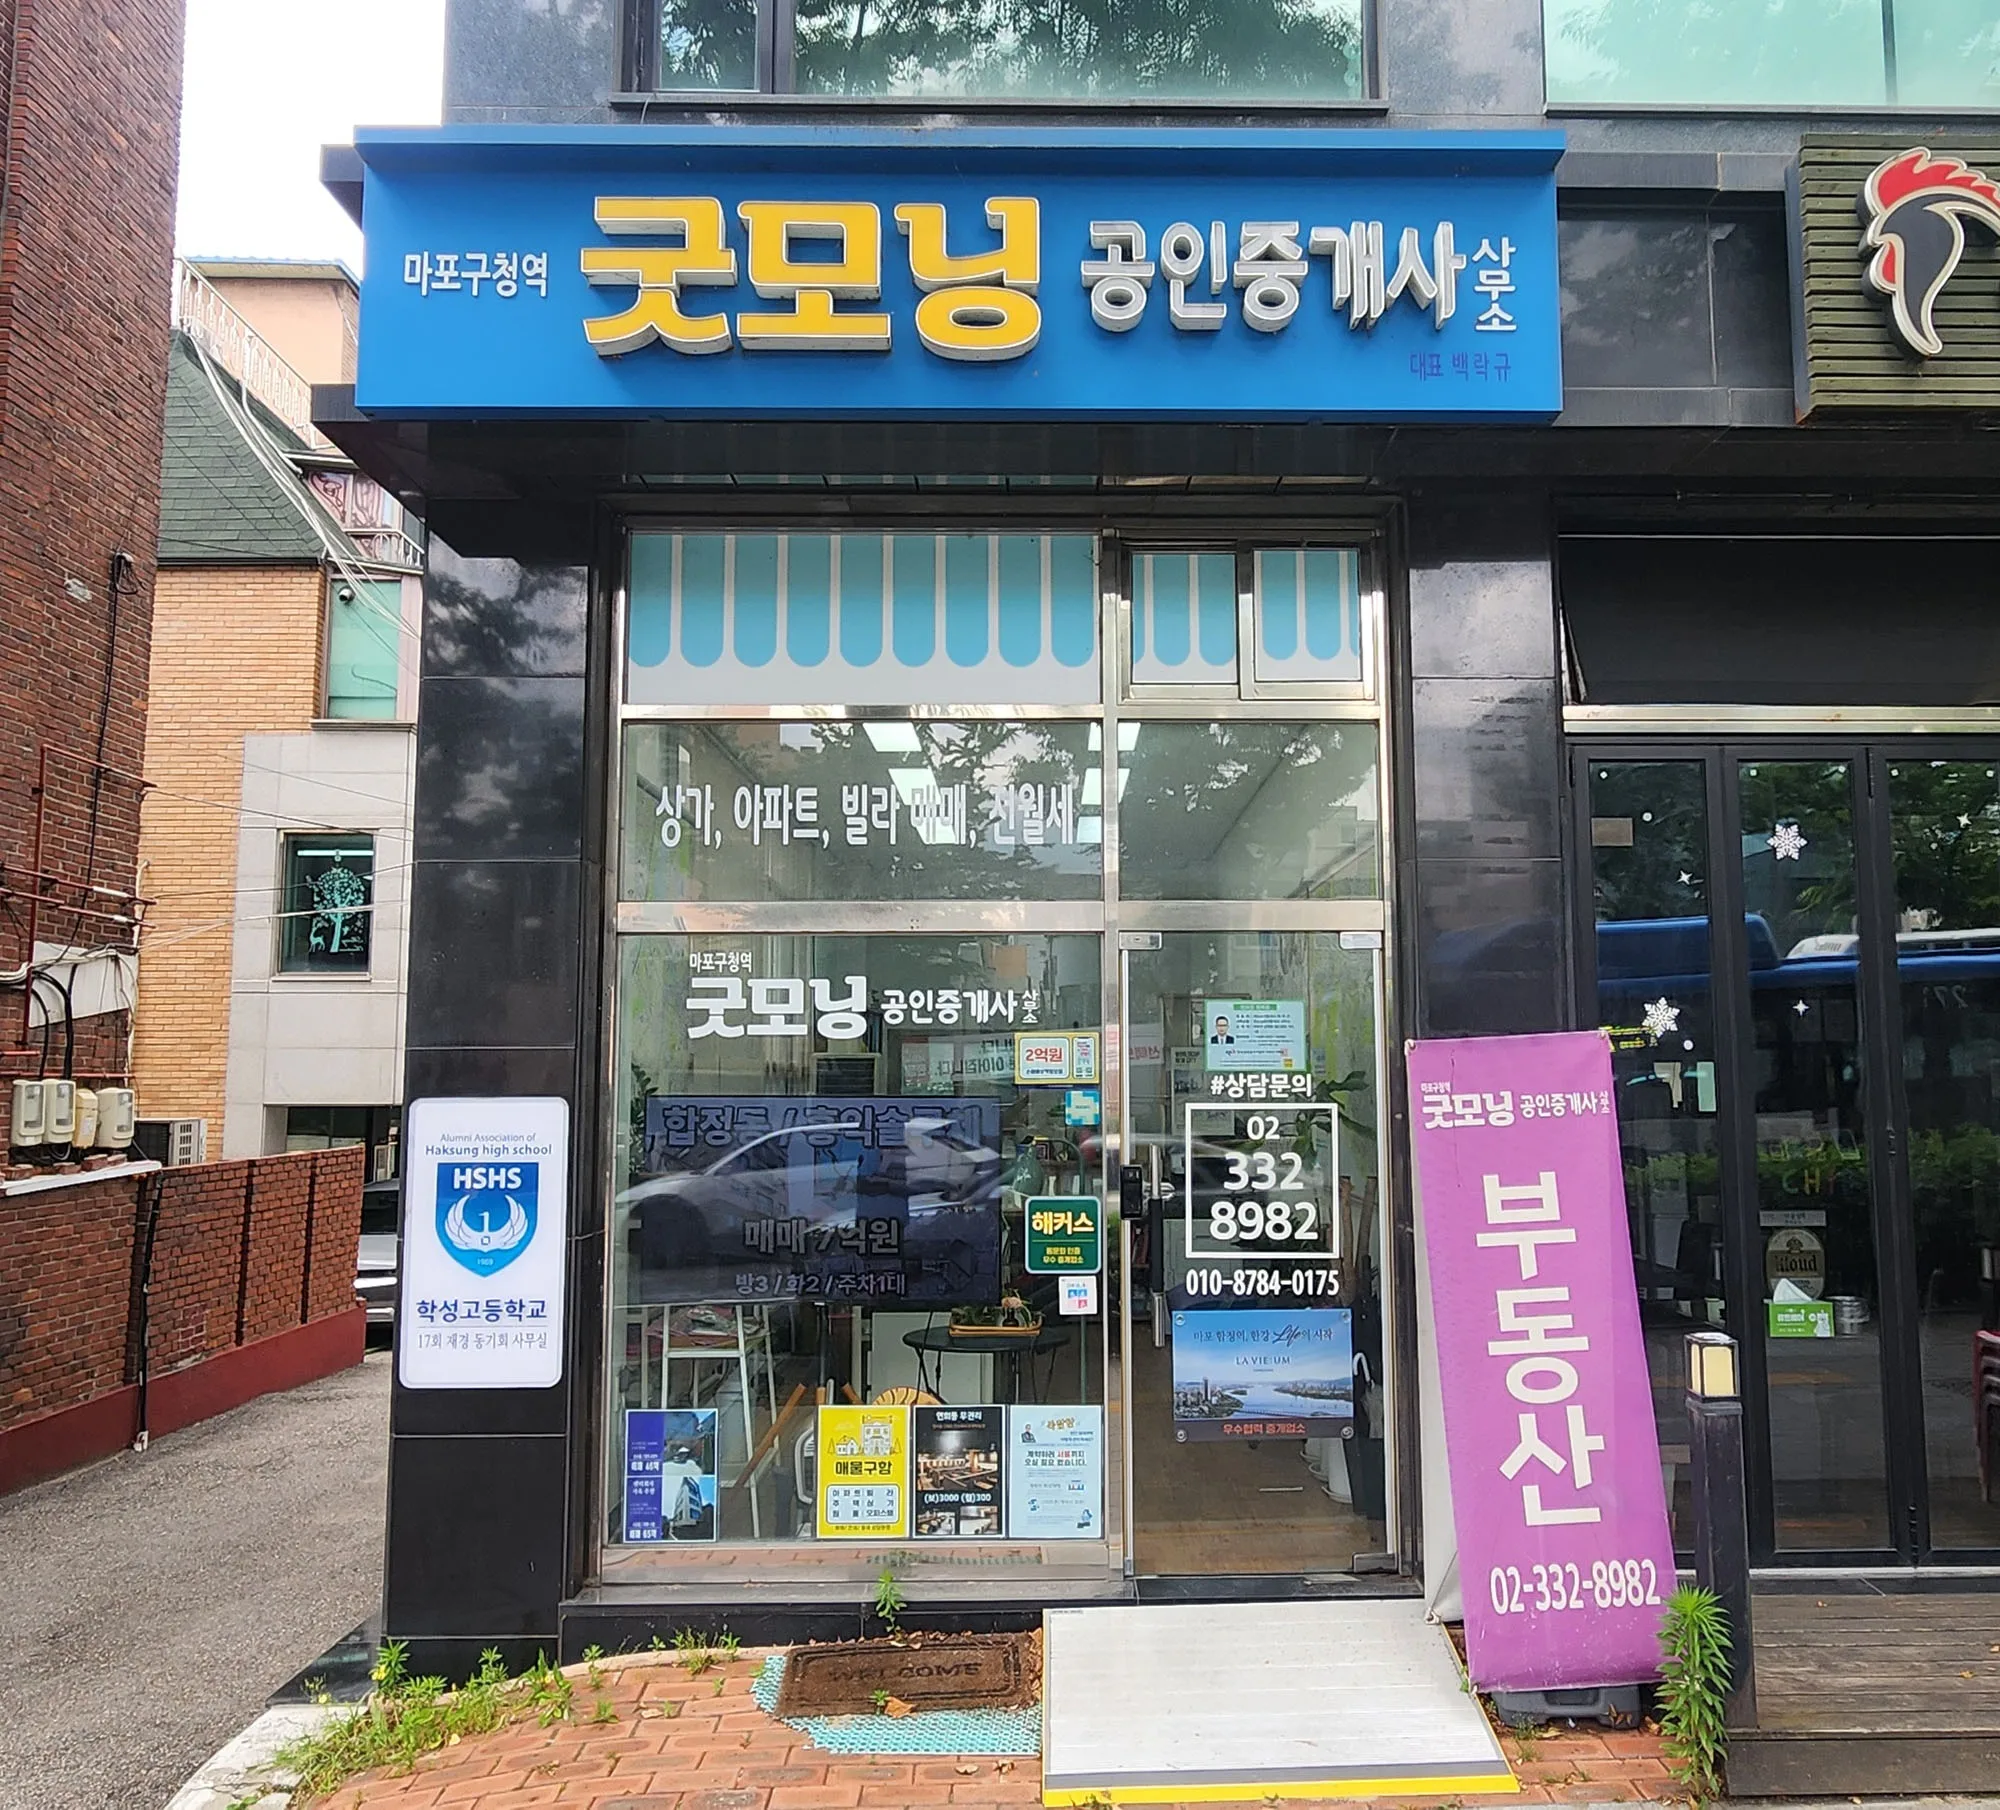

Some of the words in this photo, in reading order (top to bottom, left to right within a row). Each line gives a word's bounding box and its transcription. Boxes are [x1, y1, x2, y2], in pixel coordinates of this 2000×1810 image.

[403, 251, 548, 297] 마포구청역
[580, 196, 1042, 360] 굿모닝
[1080, 220, 1467, 333] 공인중개사
[1409, 352, 1443, 382] 대표
[656, 783, 722, 850] 상가,
[733, 784, 830, 850] 아파트,
[842, 784, 899, 846] 빌라
[689, 952, 752, 973] 마포구청역
[686, 975, 868, 1040] 굿모닝
[880, 990, 1018, 1025] 공인중개사
[1025, 1047, 1063, 1062] 2억원
[1210, 1073, 1313, 1098] #상담문의
[1422, 1091, 1515, 1130] 굿모닝
[1520, 1090, 1598, 1118] 공인중개사
[440, 1133, 472, 1142] Alumni
[475, 1133, 525, 1142] Association
[526, 1133, 536, 1141] of
[662, 1104, 776, 1149] 합정동
[1247, 1116, 1280, 1140] 02
[425, 1145, 479, 1157] Haksung
[482, 1144, 509, 1157] high
[512, 1143, 552, 1155] school
[453, 1167, 522, 1190] HSHS
[1223, 1151, 1304, 1190] 332
[1031, 1211, 1095, 1235] 해커스
[1210, 1201, 1318, 1240] 8982
[744, 1218, 806, 1254] 매매
[1186, 1268, 1340, 1296] 010-8784-0175
[416, 1299, 547, 1322] 학성고등학교
[419, 1333, 442, 1349] 17회
[446, 1332, 469, 1349] 재경
[474, 1332, 509, 1349] 동기회
[512, 1332, 547, 1349] 사무실
[1476, 1171, 1604, 1526] 부동산
[1265, 1423, 1306, 1435] 중개업소
[835, 1461, 892, 1475] 매물구함
[1490, 1559, 1661, 1615] 02-332-8982
